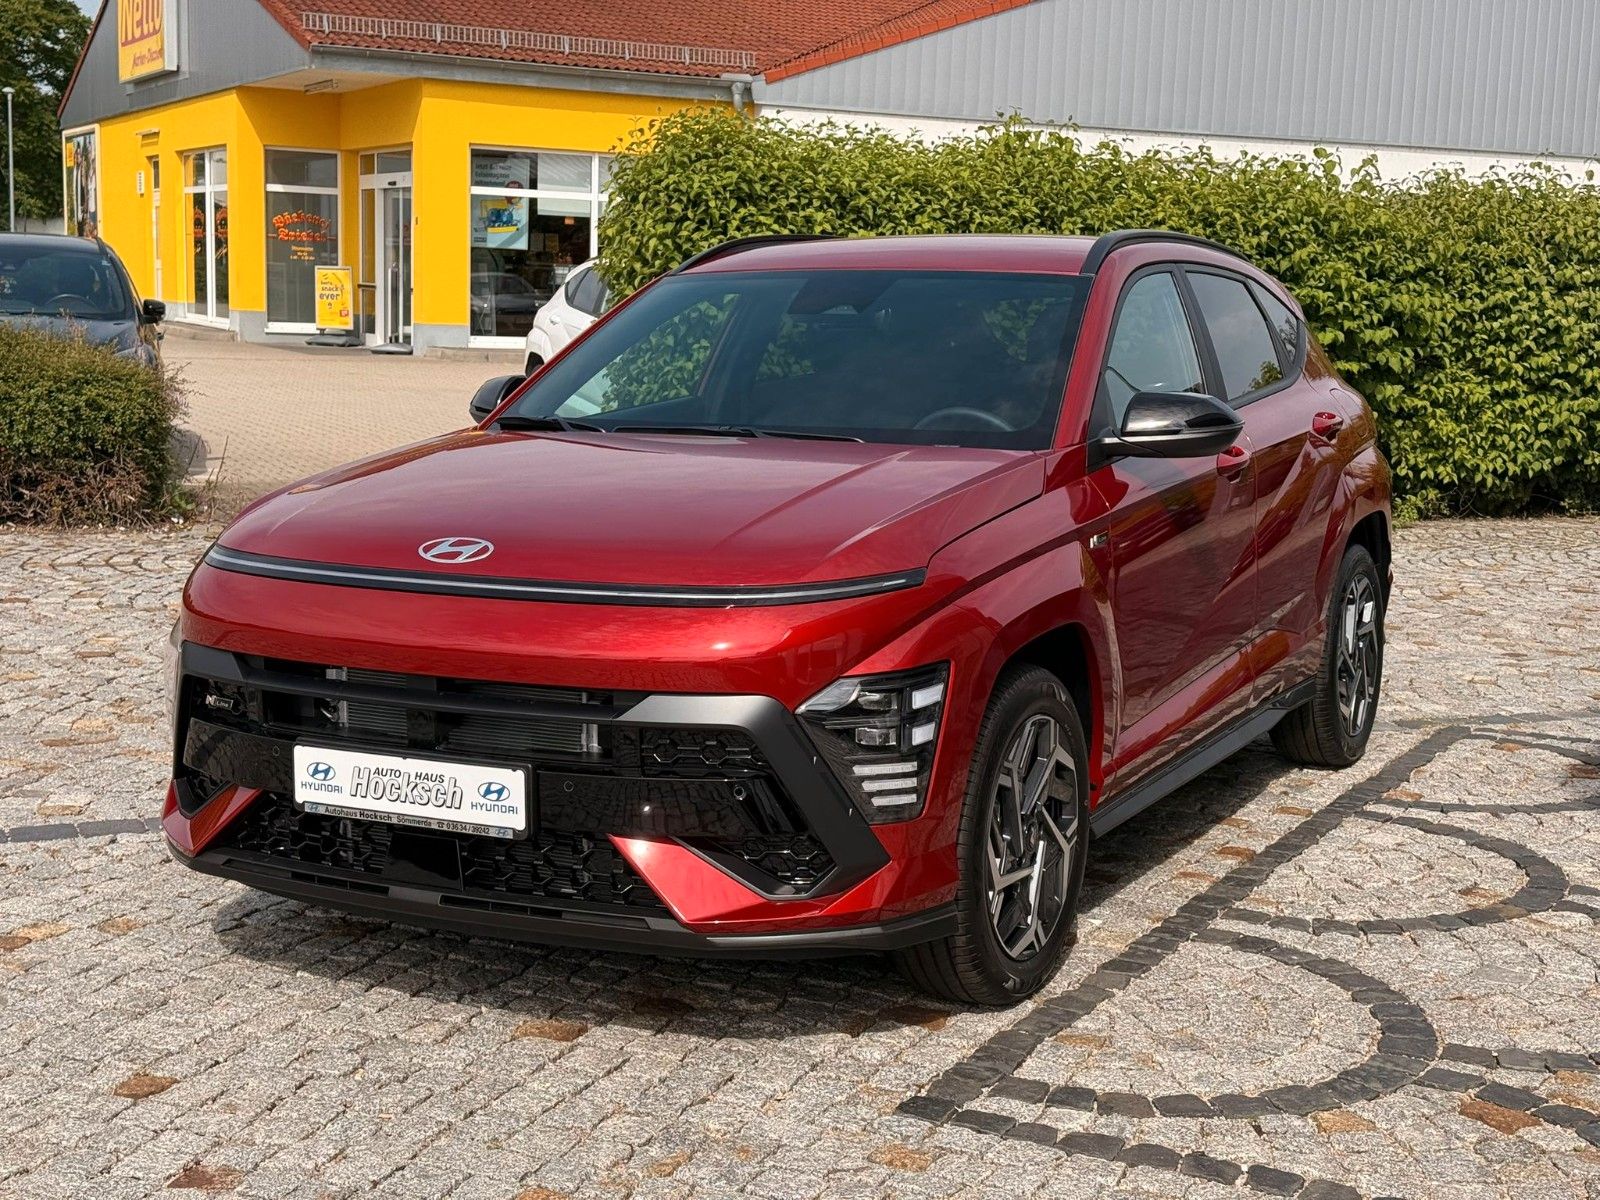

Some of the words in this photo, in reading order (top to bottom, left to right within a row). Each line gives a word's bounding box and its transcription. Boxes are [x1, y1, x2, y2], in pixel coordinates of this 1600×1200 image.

[373, 767, 401, 779] AUTO
[414, 772, 445, 783] HAUS
[301, 781, 343, 794] HYUNDAI
[349, 766, 463, 810] Hocksch
[470, 801, 518, 815] HYUNDAI
[324, 806, 358, 818] Autohaus
[359, 810, 392, 822] Hocksch
[396, 815, 432, 827] Sömmerda
